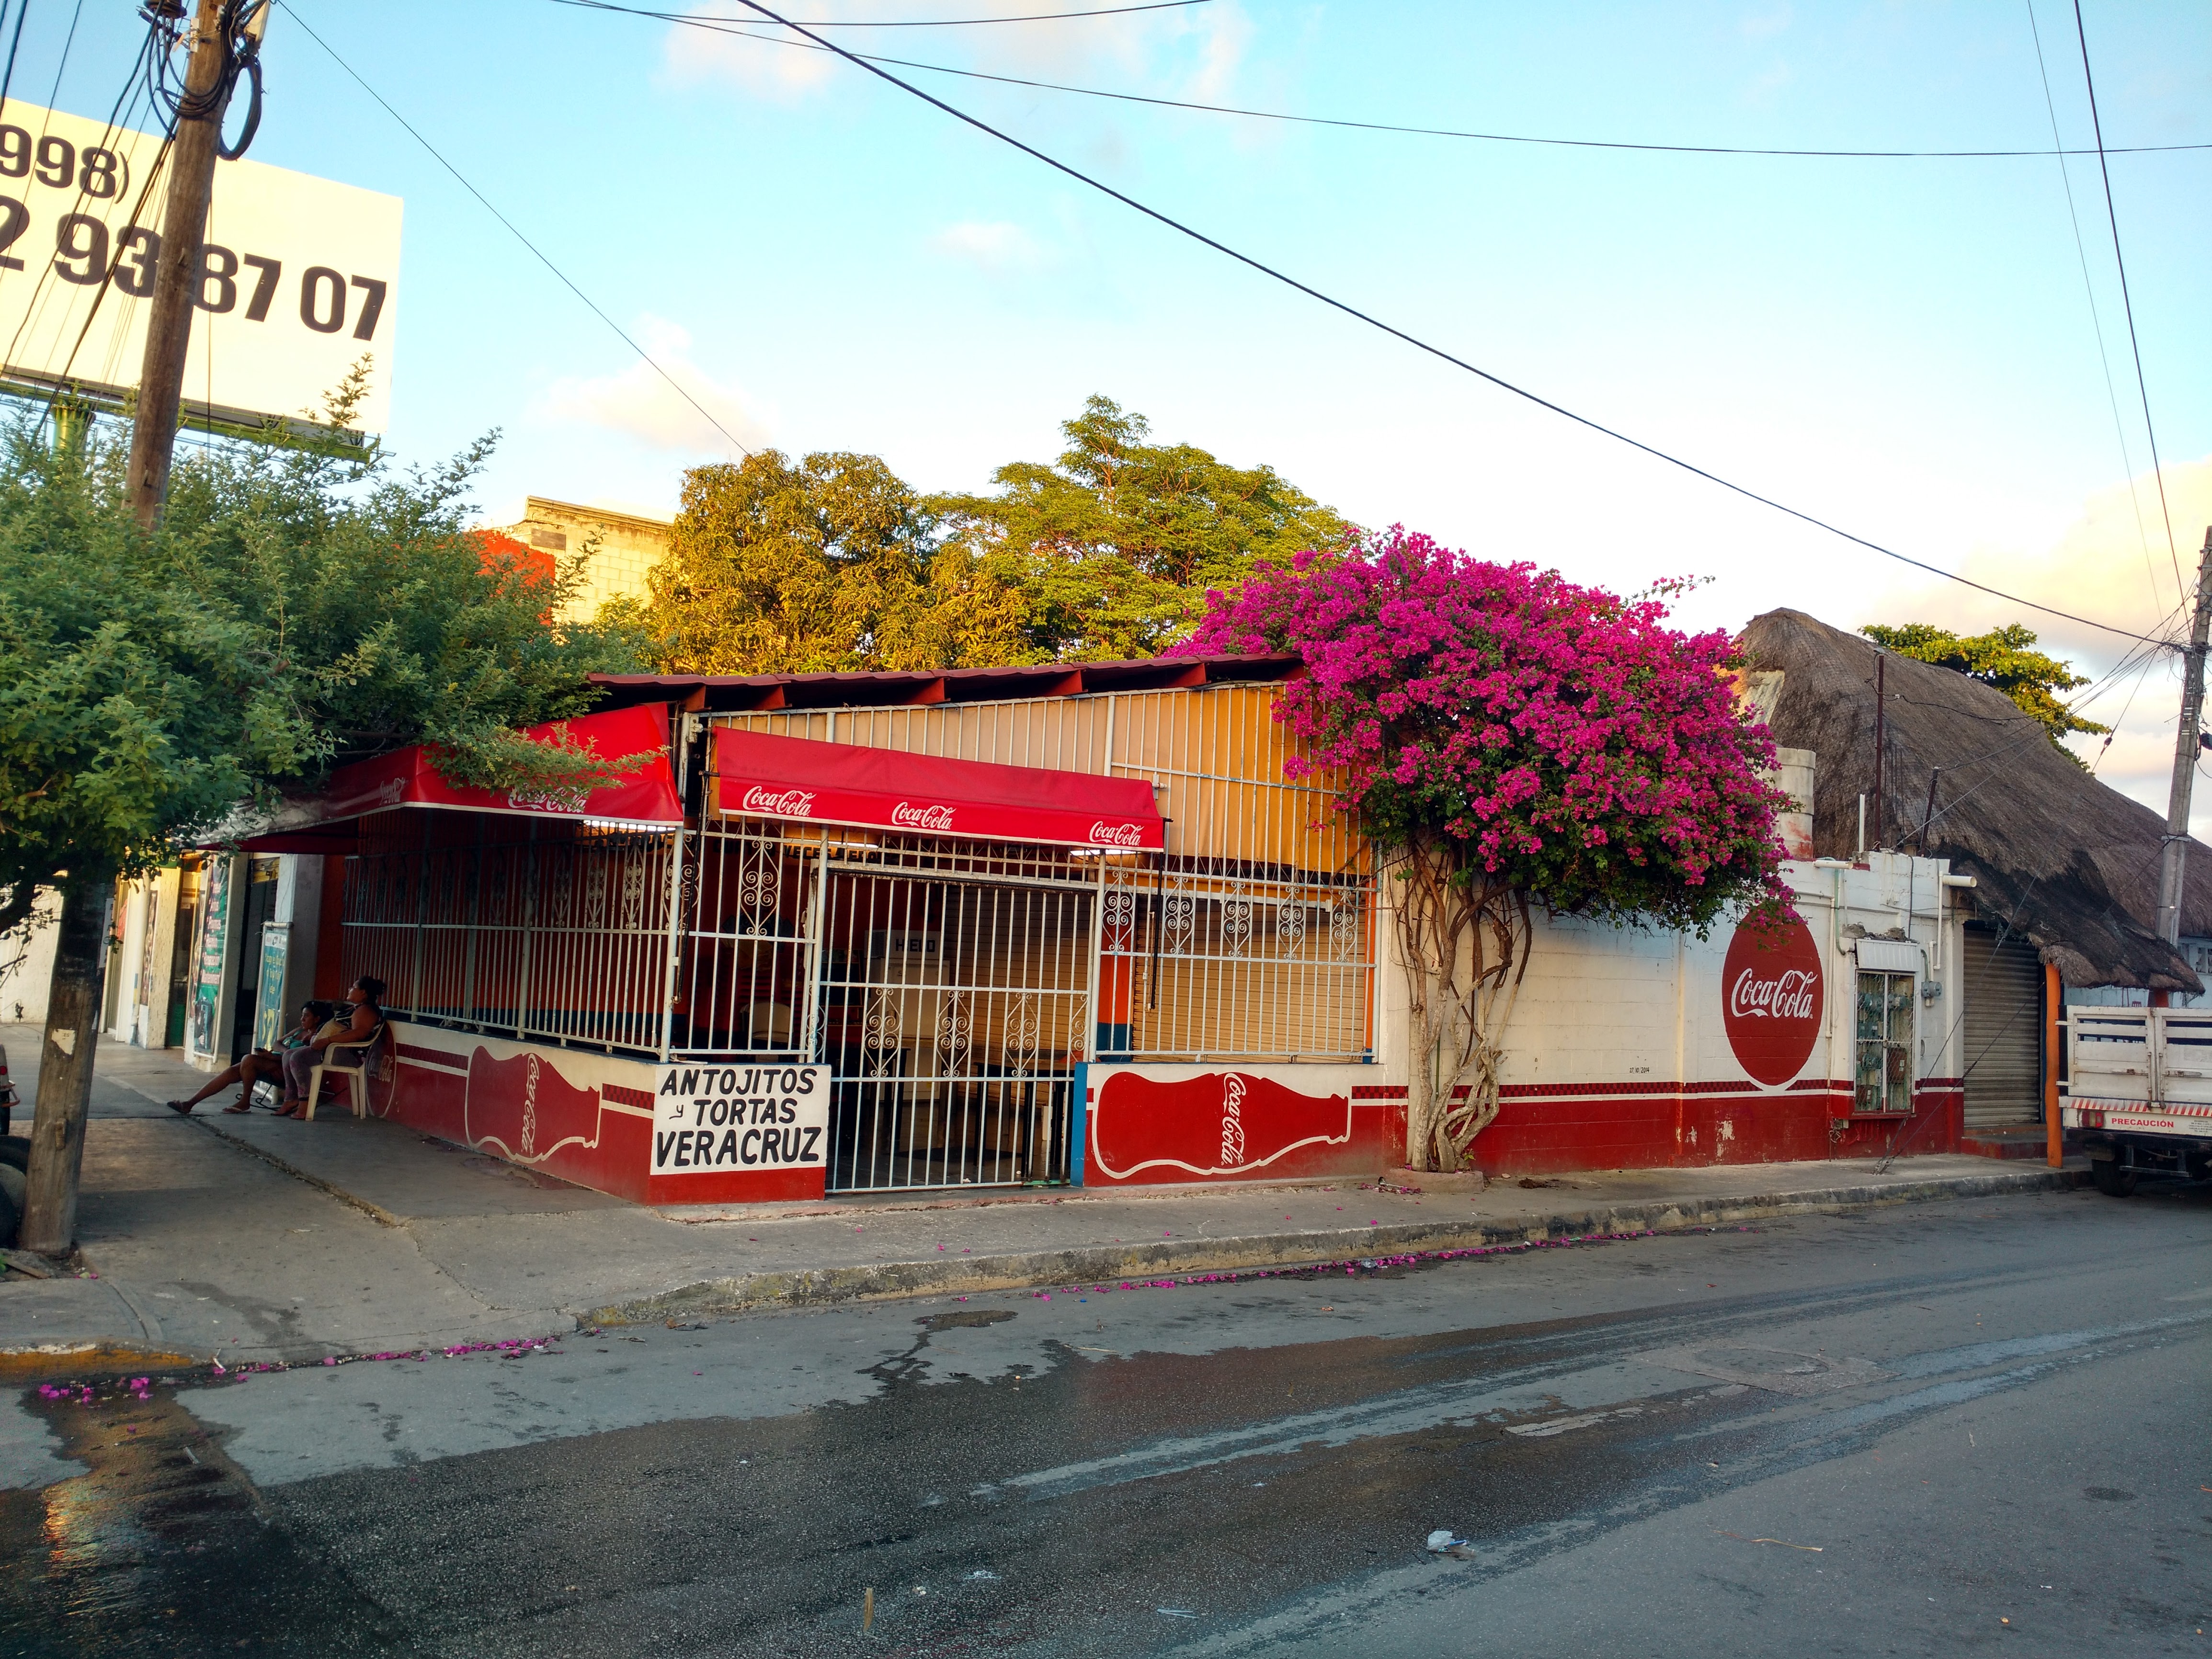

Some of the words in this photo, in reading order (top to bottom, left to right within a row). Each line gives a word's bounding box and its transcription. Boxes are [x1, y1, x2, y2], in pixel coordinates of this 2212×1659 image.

[300, 266, 387, 342] 07
[742, 785, 817, 817] Coca-Cola
[891, 802, 957, 830] Coca-Cola
[1089, 820, 1145, 846] Coca-Cola
[895, 939, 935, 953] HELO
[1731, 968, 1818, 1019] Coca-Cola
[660, 1068, 817, 1096] ANTOJITOS
[521, 1053, 540, 1158] Coca-Cola
[669, 1104, 684, 1120] y
[693, 1098, 798, 1126] TORTAS
[1221, 1073, 1246, 1166] Coca-Cola
[2111, 1117, 2174, 1128] PRECAUCIÓN
[657, 1126, 822, 1167] VERACRUZ
